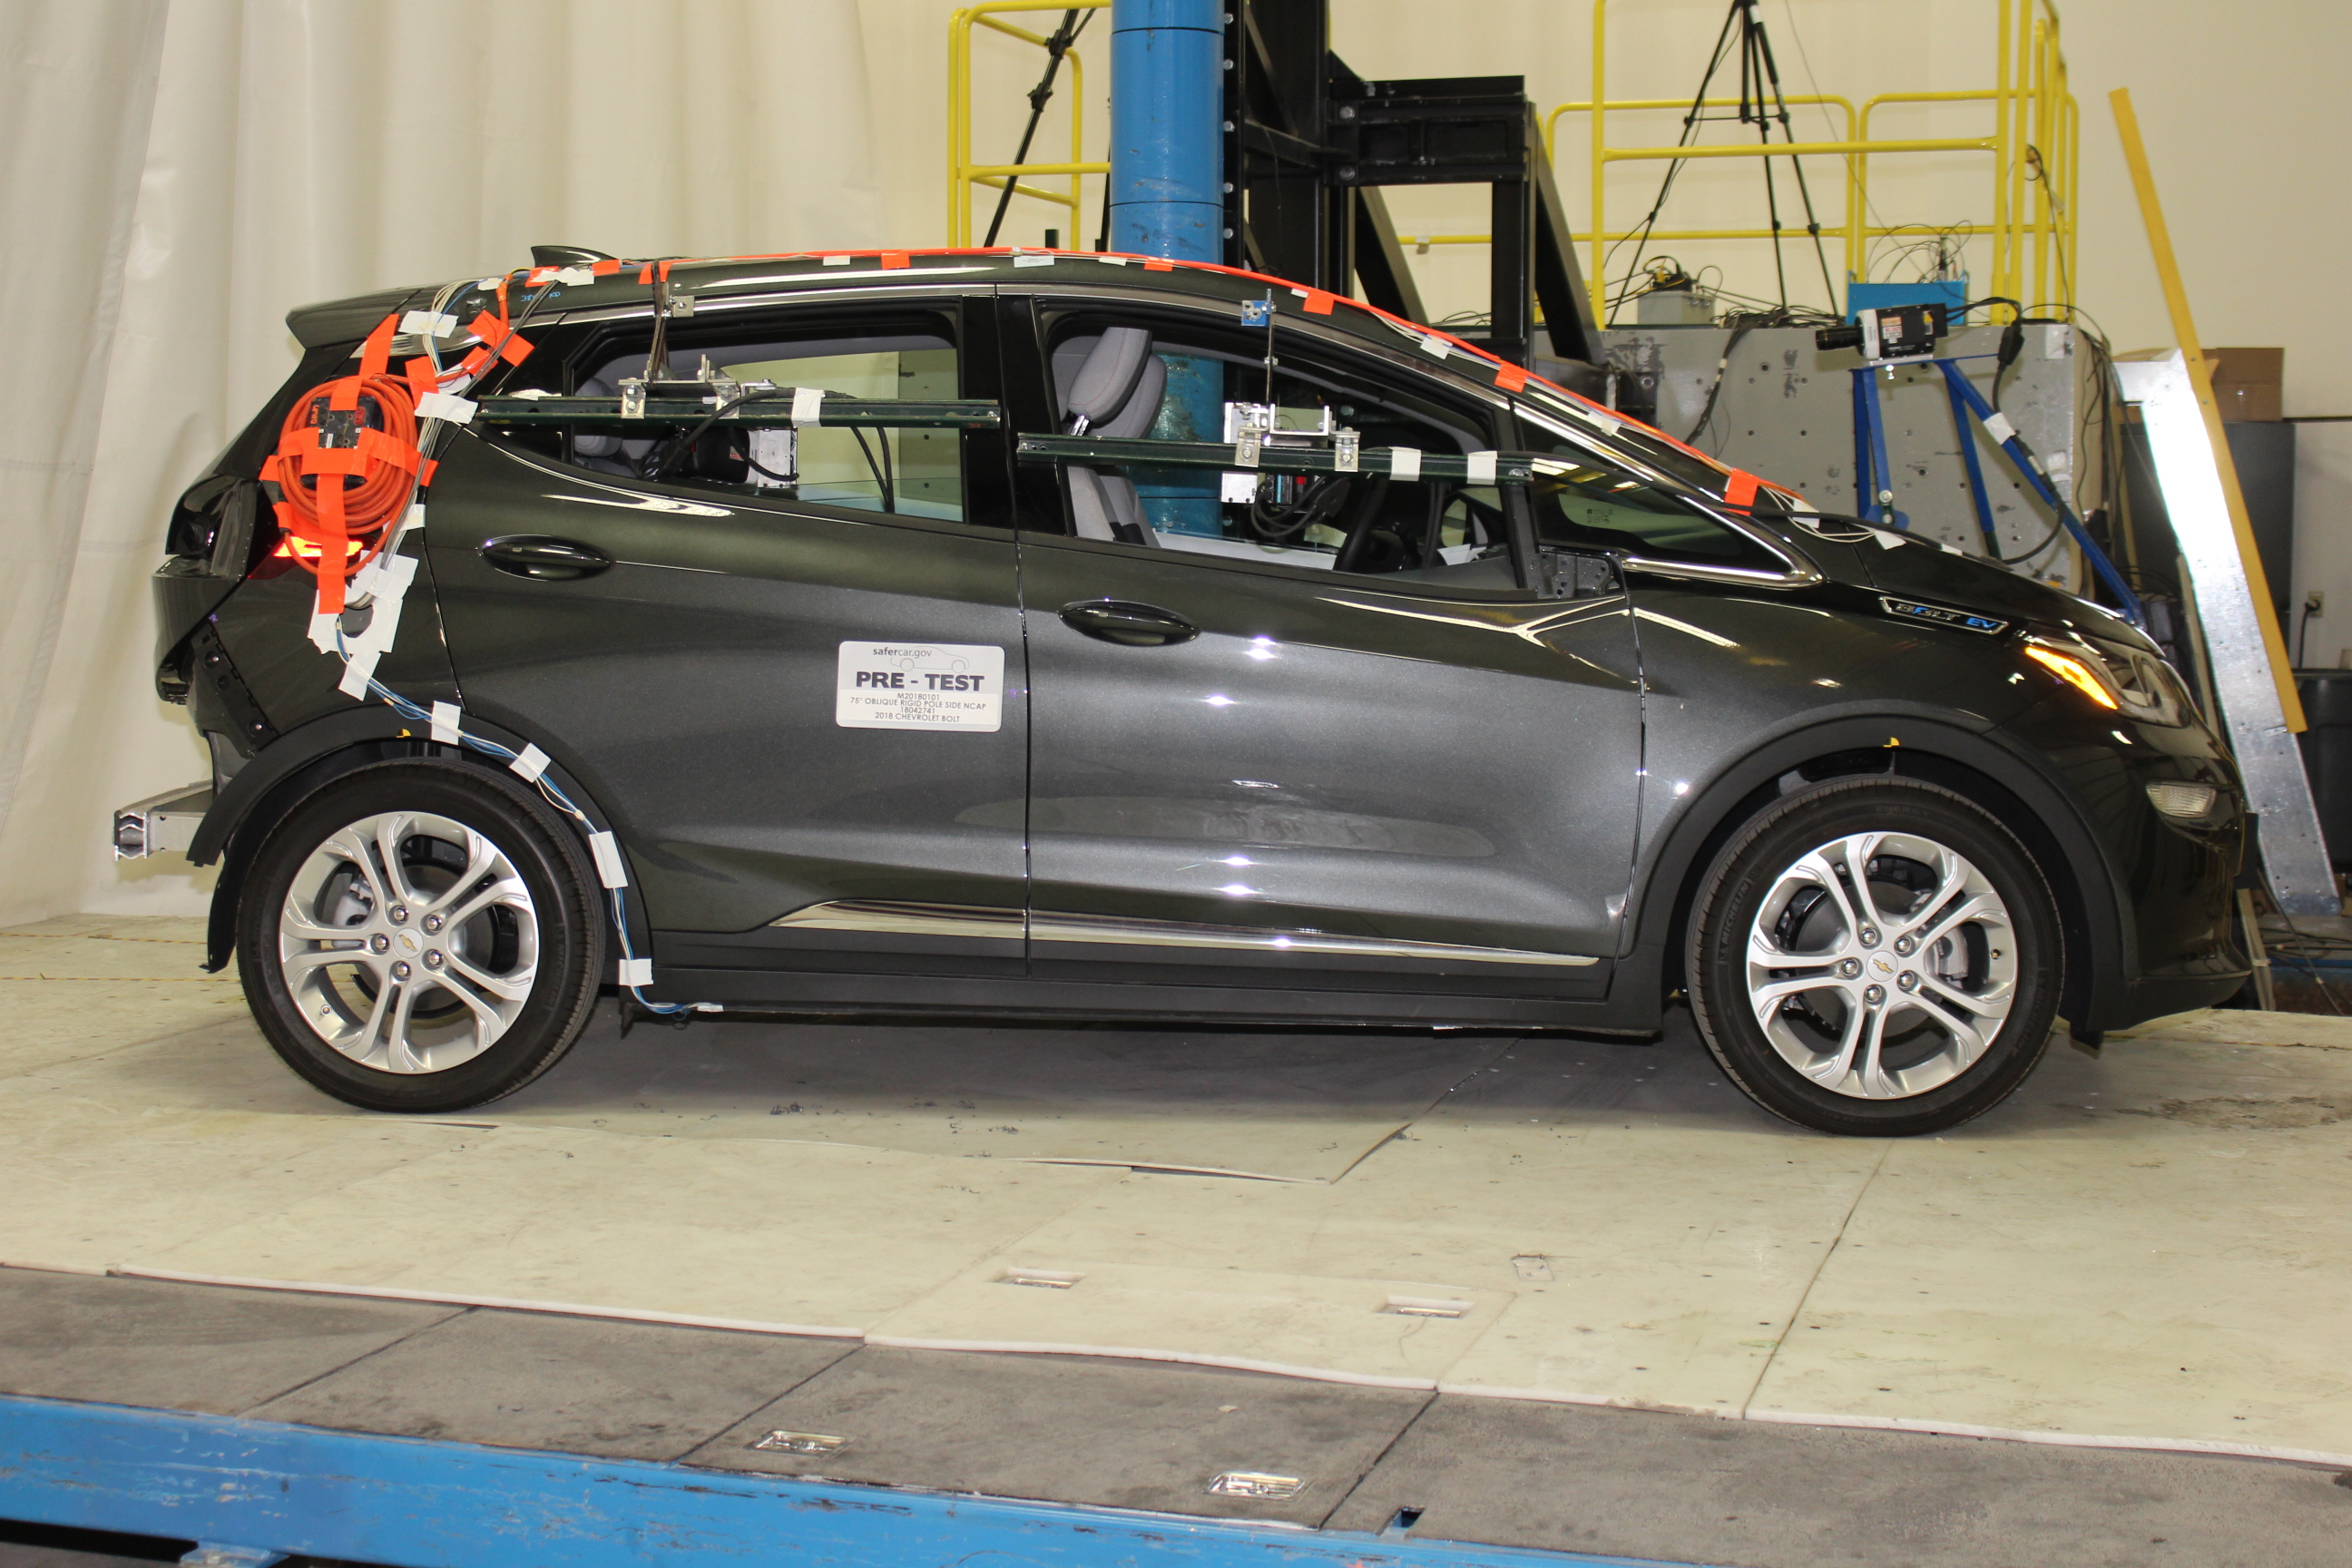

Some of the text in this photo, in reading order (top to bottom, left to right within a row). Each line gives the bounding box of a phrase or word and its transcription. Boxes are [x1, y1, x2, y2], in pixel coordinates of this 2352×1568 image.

[1896, 603, 1998, 629] BOLT EV
[873, 647, 933, 659] safercar.gov
[857, 671, 905, 689] PRE
[925, 673, 985, 691] TEST
[897, 692, 940, 701] M20180101
[865, 698, 898, 706] OBLIQUE
[900, 699, 922, 707] RIGID
[964, 702, 986, 710] NCAP
[896, 712, 939, 721] CHEVROLET
[1876, 804, 1928, 818] ENERGY
[1720, 880, 1749, 944] MICHELIN
